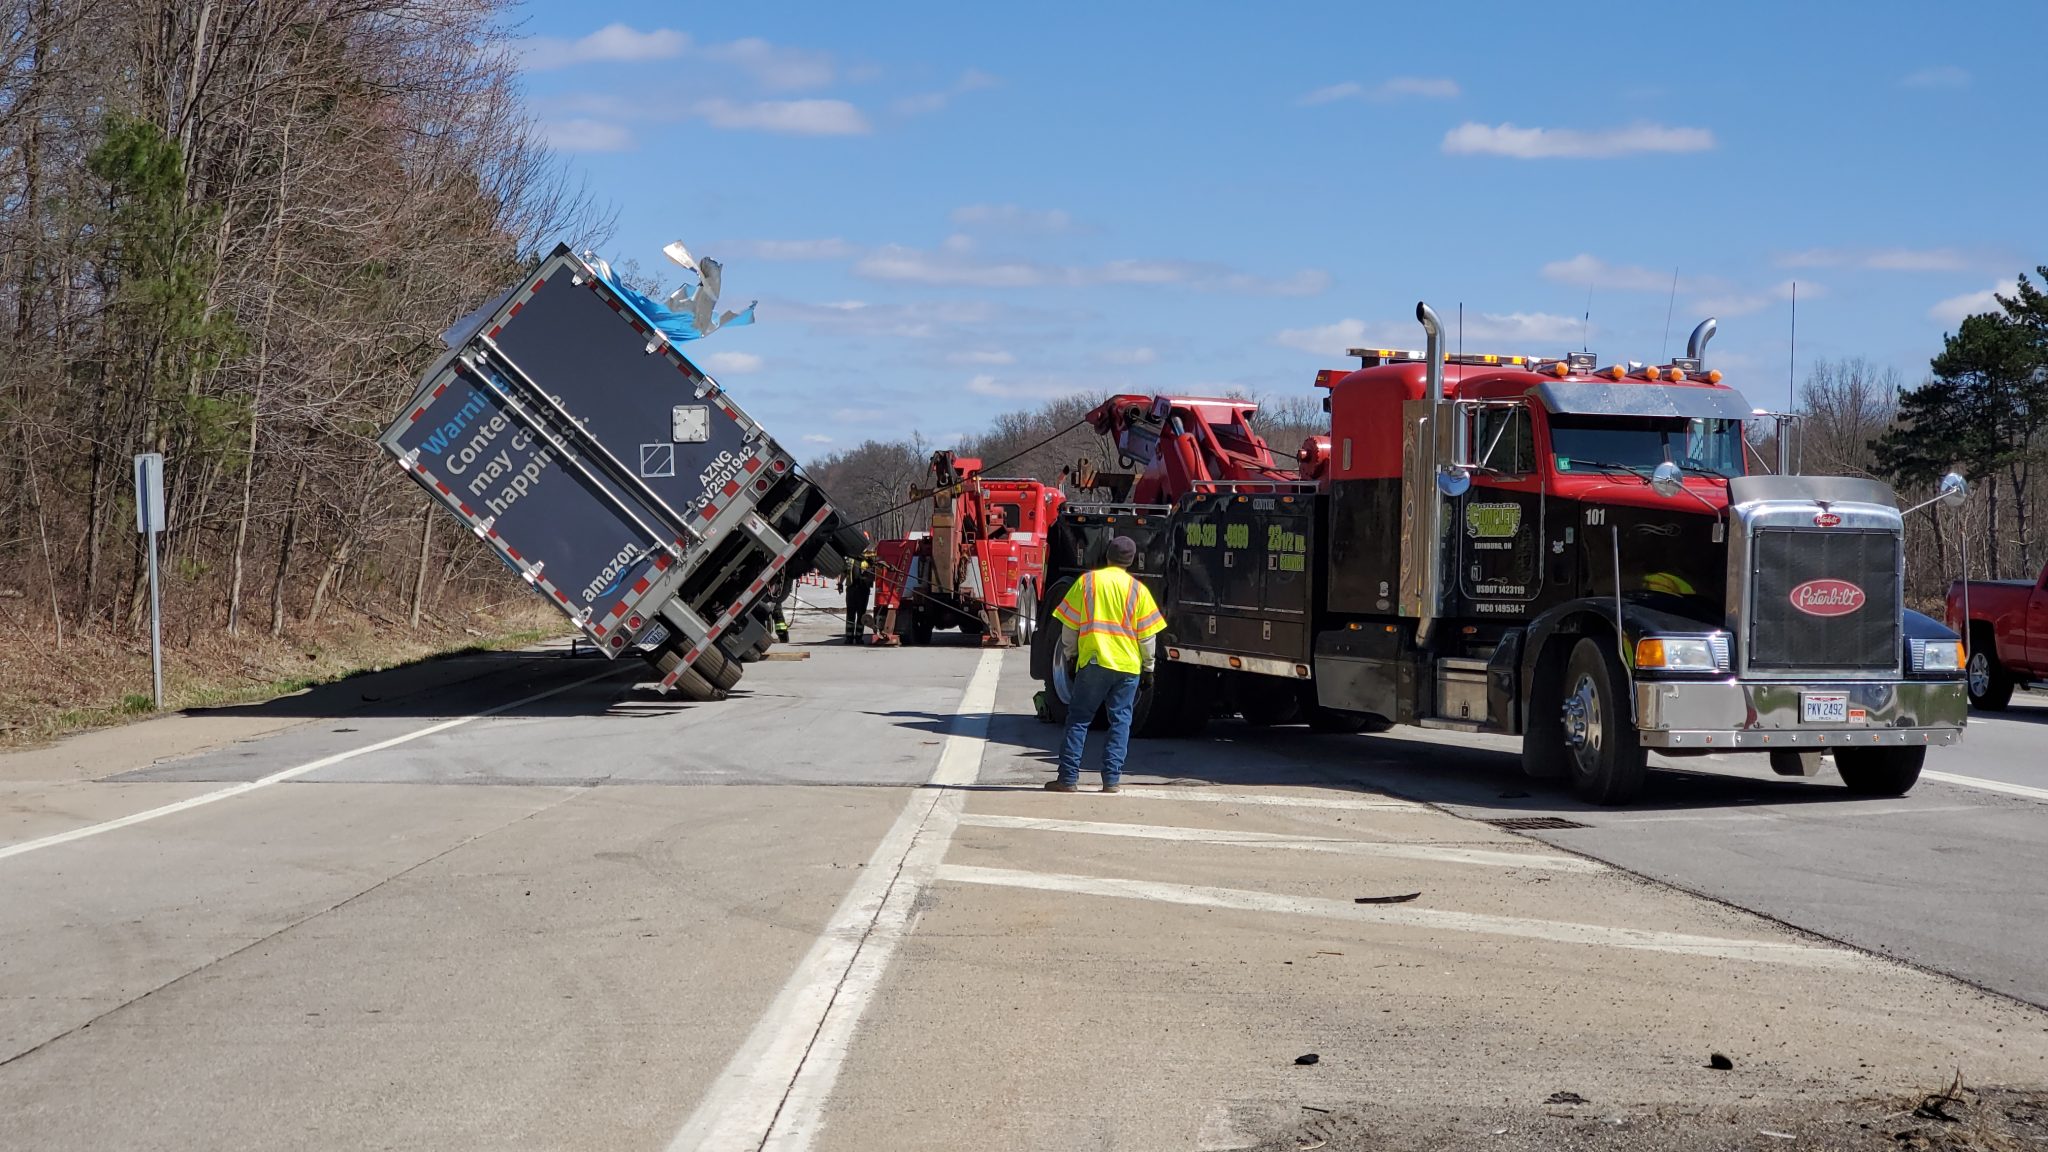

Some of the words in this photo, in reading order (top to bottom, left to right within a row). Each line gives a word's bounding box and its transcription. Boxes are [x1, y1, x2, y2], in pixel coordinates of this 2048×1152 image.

[446, 388, 532, 475] Contents
[468, 448, 513, 497] may
[511, 394, 566, 451] cause
[696, 445, 755, 509] GV2501942
[699, 449, 733, 487] AZNG
[1585, 508, 1606, 526] 101
[581, 542, 639, 602] amazon
[1476, 585, 1498, 594] USDOT
[1799, 586, 1860, 607] Peterbilt
[1823, 703, 1843, 716] 2492
